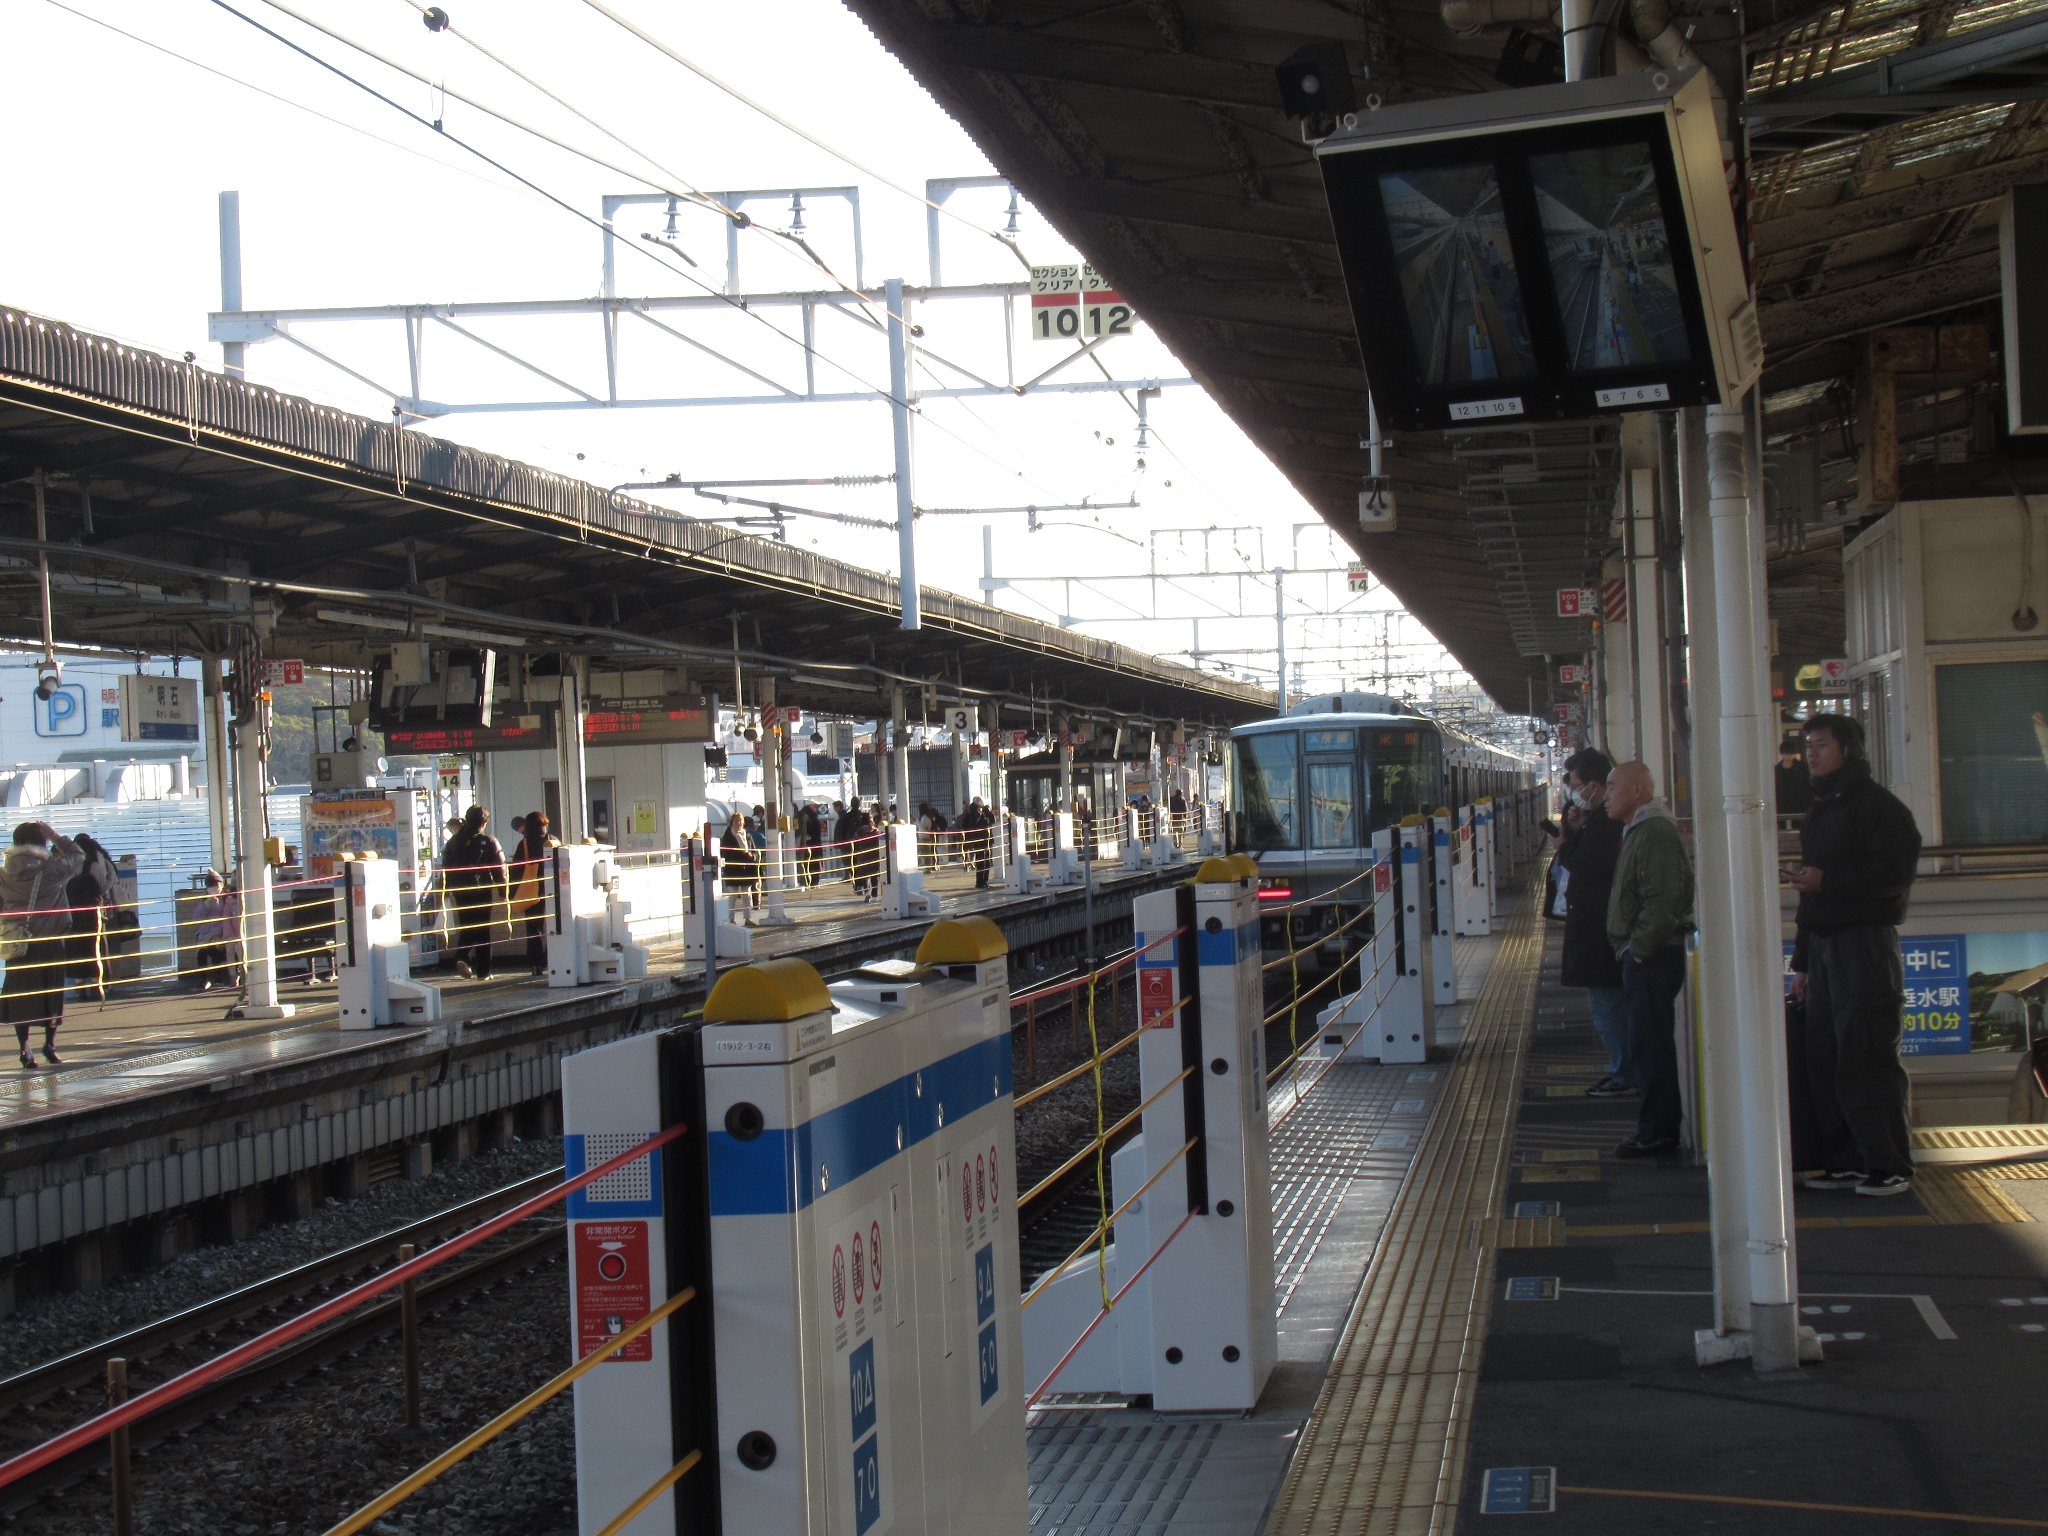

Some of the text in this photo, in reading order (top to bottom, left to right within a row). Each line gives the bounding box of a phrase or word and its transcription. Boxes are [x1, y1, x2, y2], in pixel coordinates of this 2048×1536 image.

[1032, 268, 1077, 278] セクション
[1038, 280, 1073, 292] クリア
[1089, 278, 1108, 288] クリ
[1038, 308, 1078, 337] 10
[1090, 306, 1130, 334] 12
[1603, 388, 1662, 402] 8 7 6 5
[1458, 402, 1516, 416] 12 11 10 9
[1350, 580, 1368, 592] 14
[102, 688, 119, 704] 明
[158, 686, 178, 706] 明石
[700, 697, 706, 706] 3
[48, 692, 75, 731] P
[955, 712, 967, 730] 3
[1198, 739, 1205, 750] 3
[442, 776, 459, 787] 14
[1901, 950, 1951, 971] 中に
[1903, 987, 1960, 1008] 垂水駅
[1904, 1012, 1961, 1031] 約10分
[718, 1042, 771, 1051] (19)2-3-2右
[586, 1226, 637, 1235] 非常開ボタン
[978, 1268, 984, 1304] 9
[982, 1347, 987, 1384] 6
[852, 1369, 863, 1417] 10
[858, 1468, 863, 1513] 7
